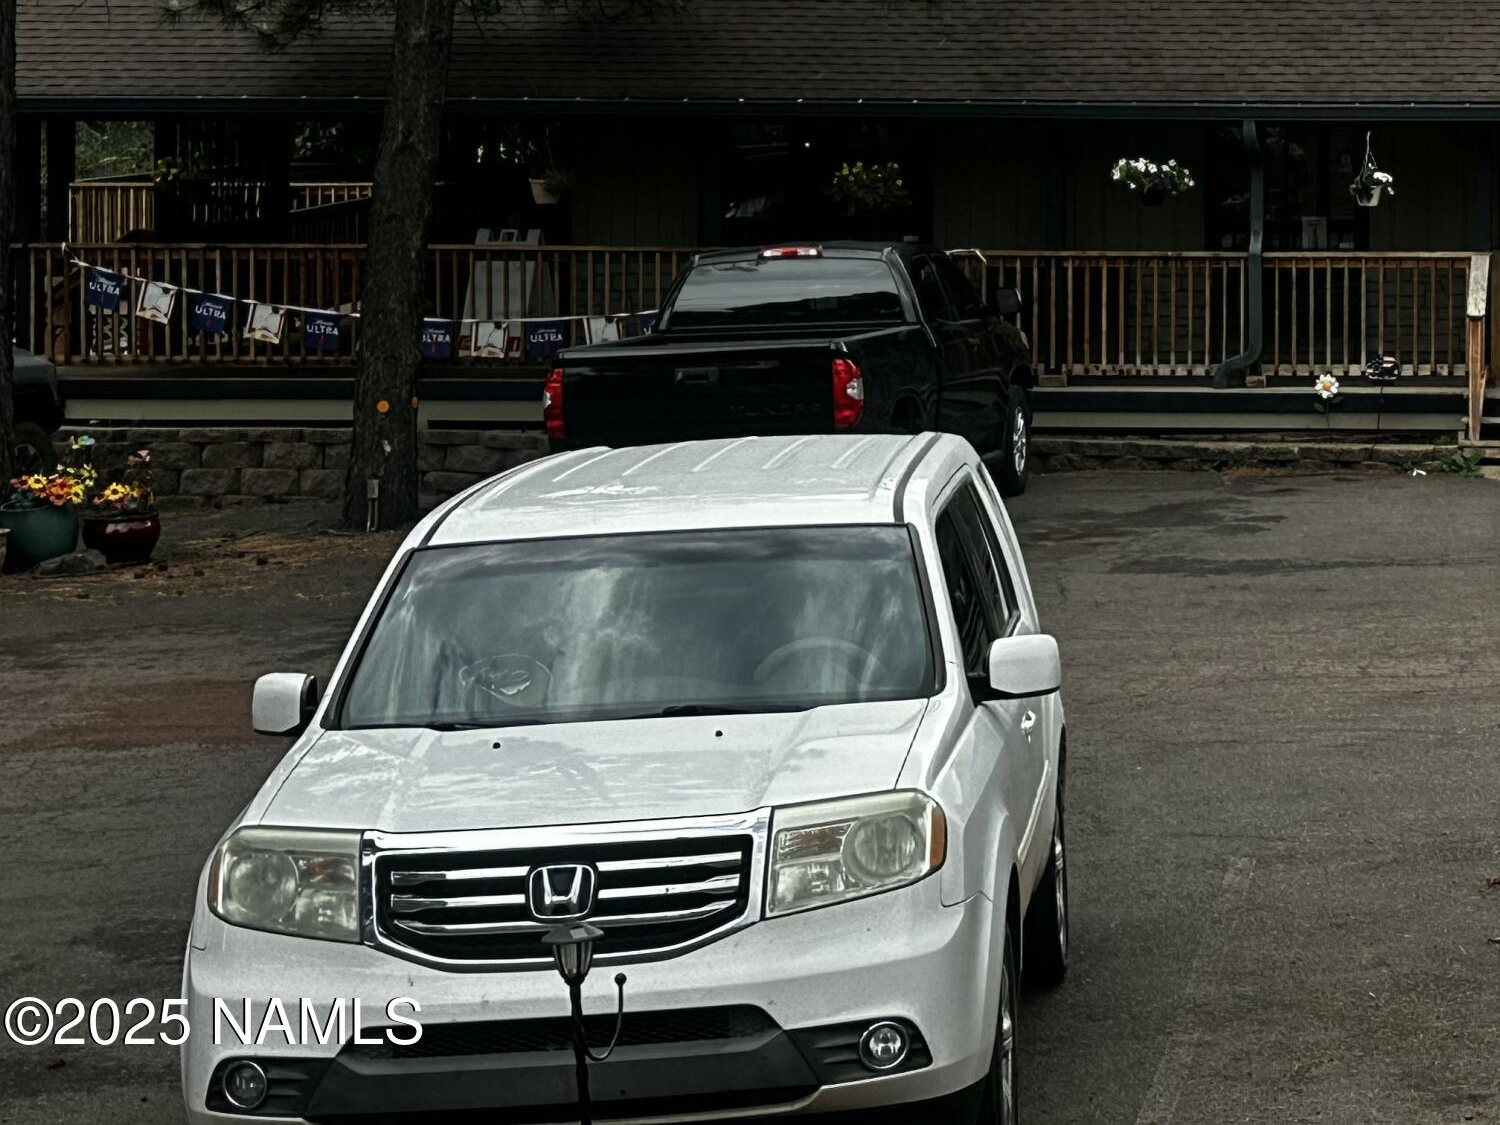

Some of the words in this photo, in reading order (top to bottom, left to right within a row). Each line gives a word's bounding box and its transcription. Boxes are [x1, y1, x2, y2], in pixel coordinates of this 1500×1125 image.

[89, 281, 120, 295] ULTRA
[195, 305, 226, 319] ULTRA
[306, 324, 339, 336] ULTRA
[530, 333, 563, 342] ULTRA
